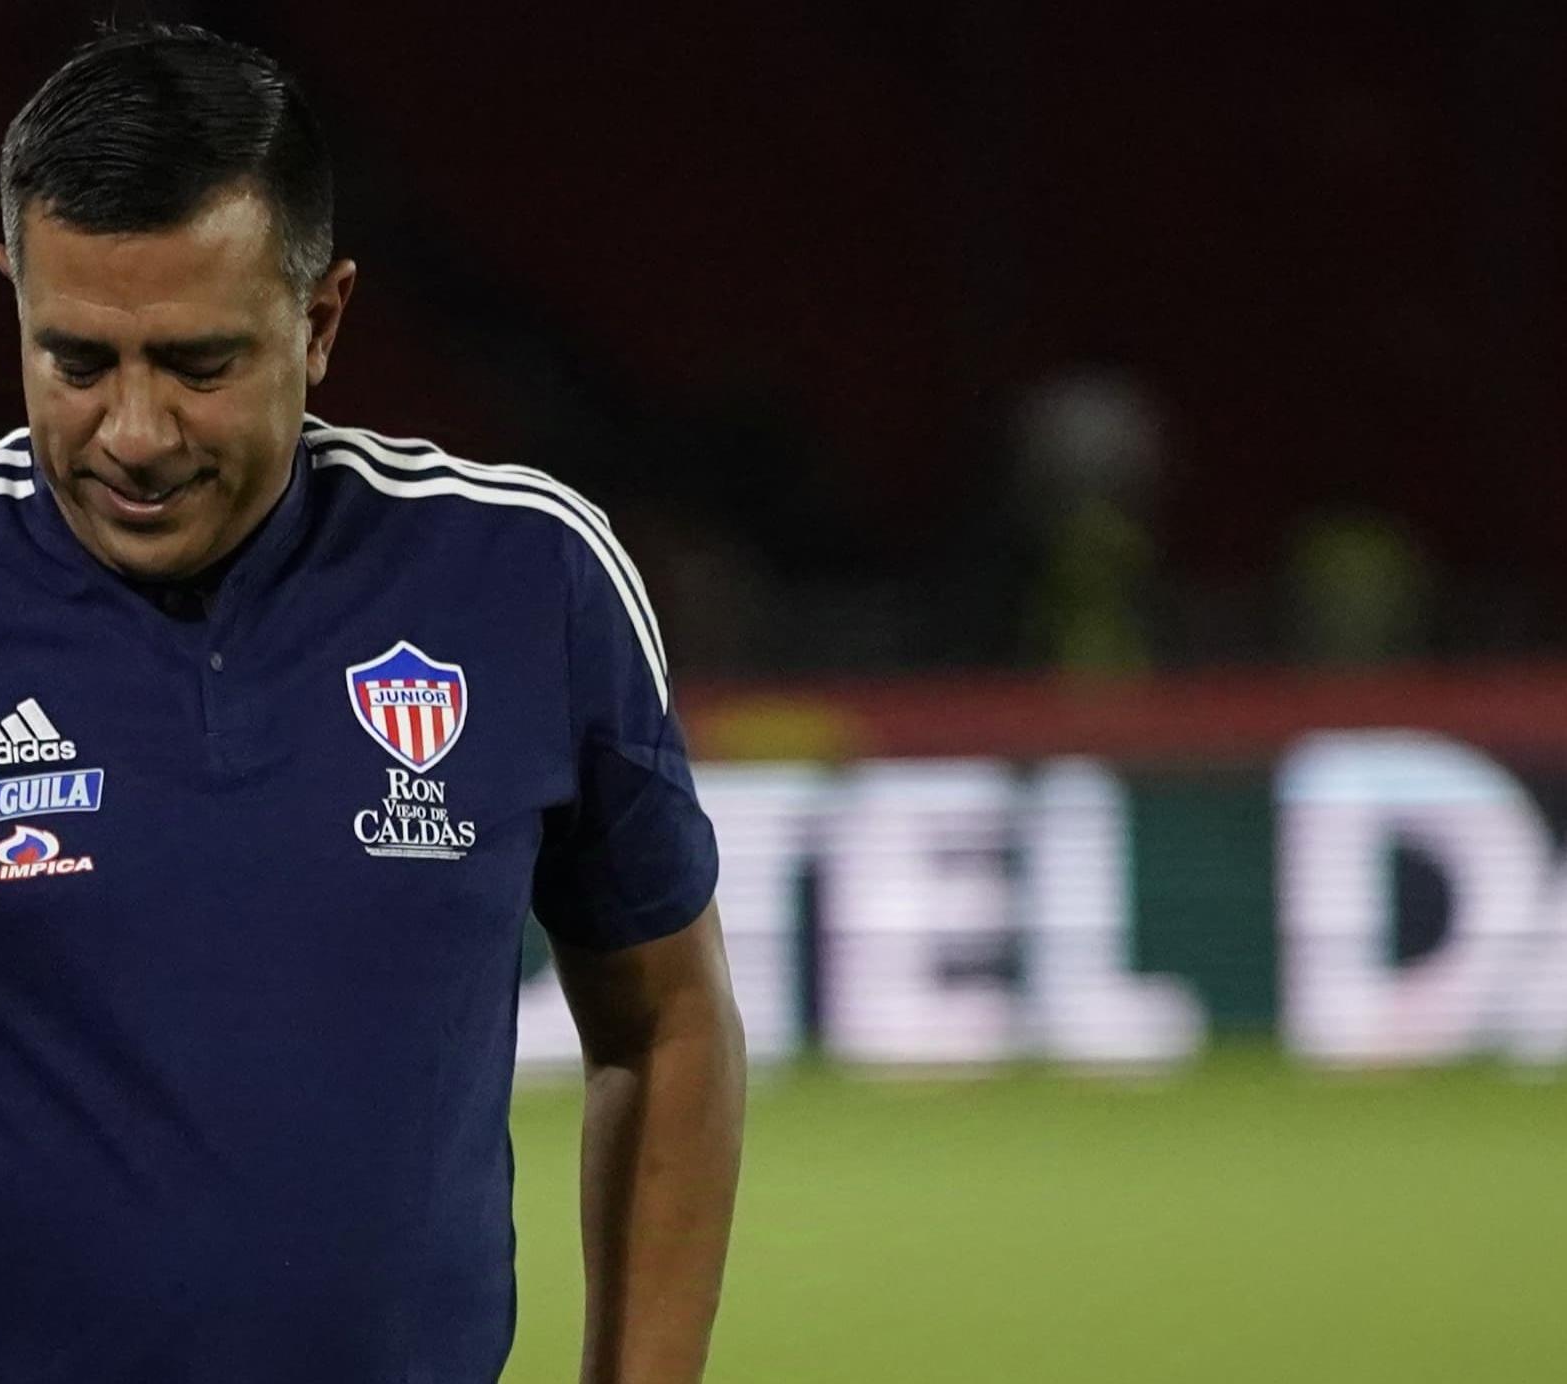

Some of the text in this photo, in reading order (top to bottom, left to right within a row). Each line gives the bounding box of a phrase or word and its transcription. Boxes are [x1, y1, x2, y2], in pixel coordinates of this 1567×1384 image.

[374, 690, 447, 704] JUNIOR
[387, 768, 444, 803] RON
[382, 798, 449, 821] VIEJO DE
[354, 810, 475, 847] CALDAS
